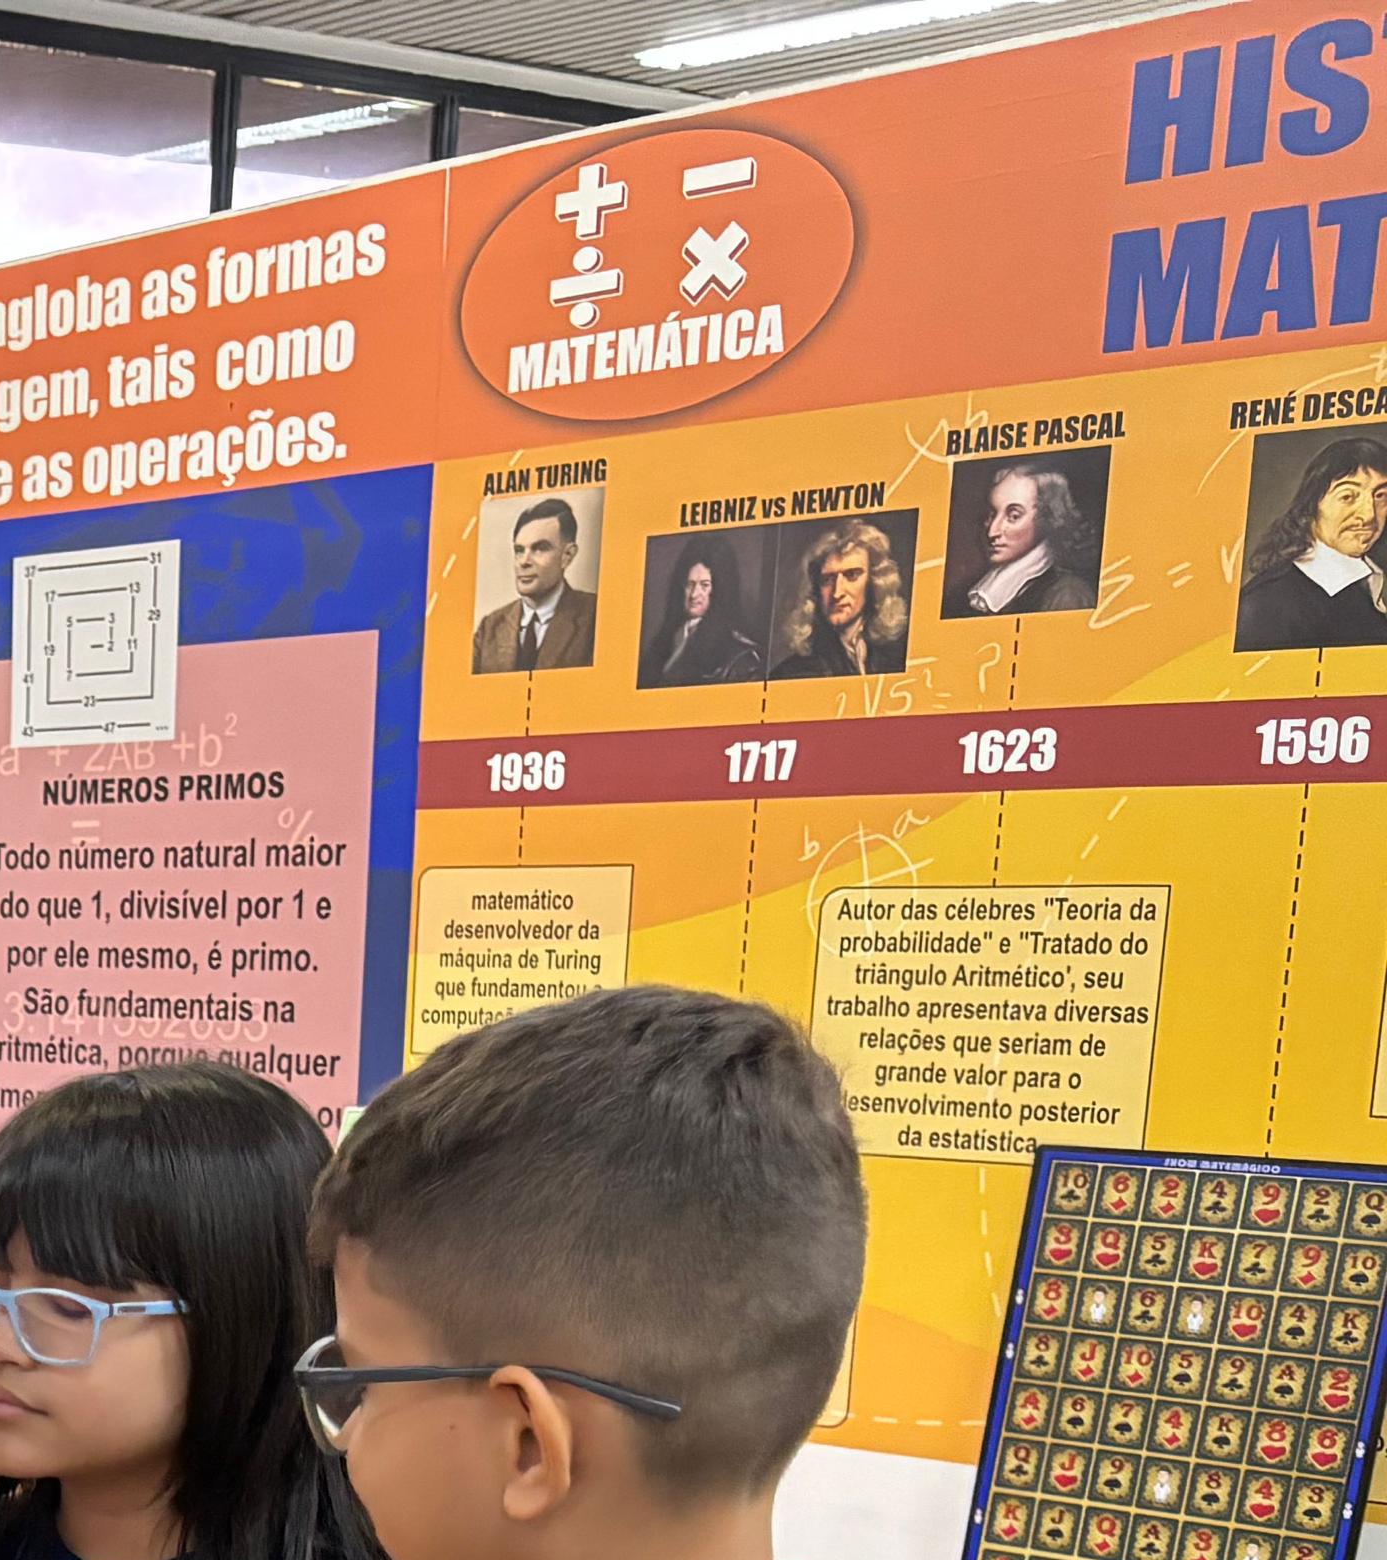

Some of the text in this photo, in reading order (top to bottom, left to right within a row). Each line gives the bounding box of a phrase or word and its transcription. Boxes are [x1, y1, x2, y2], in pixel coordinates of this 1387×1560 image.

[1125, 12, 1387, 185] HIS
[141, 266, 196, 319] as
[207, 223, 386, 308] formas
[1102, 191, 1387, 354] MAT
[108, 345, 196, 408] tais
[215, 320, 355, 391] como
[508, 303, 785, 392] MATEMÁTICA
[1230, 387, 1387, 429] RENÉ DESCA
[945, 412, 1126, 456] BLAISE PASCAL
[22, 450, 74, 498] as
[82, 411, 347, 497] operações.
[484, 459, 608, 495] ALAN TURING
[679, 483, 885, 527] LEIBNIZ vs NEWTON
[957, 727, 1059, 775] 1623
[1256, 716, 1371, 766] 1596
[485, 752, 567, 792] 1936
[725, 739, 798, 784] 1717
[43, 772, 285, 806] NÚMEROS PRIMOS
[60, 843, 154, 869] número
[164, 838, 255, 868] natural
[266, 837, 346, 867] maior
[472, 890, 573, 910] matemático
[838, 898, 1156, 921] Autor das célebres "Teoria da
[444, 920, 599, 940] desenvolvedor da
[840, 931, 1148, 957] probabilidade" e "Tratado do
[440, 948, 601, 974] máquina de Turing
[855, 964, 946, 990] triângulo
[1084, 969, 1123, 989] seu
[23, 987, 295, 1023] São fundamentais na
[827, 996, 1148, 1024] trabalho apresentava diversas
[875, 1062, 1081, 1091] grande valor para o
[1020, 1100, 1119, 1125] posterior
